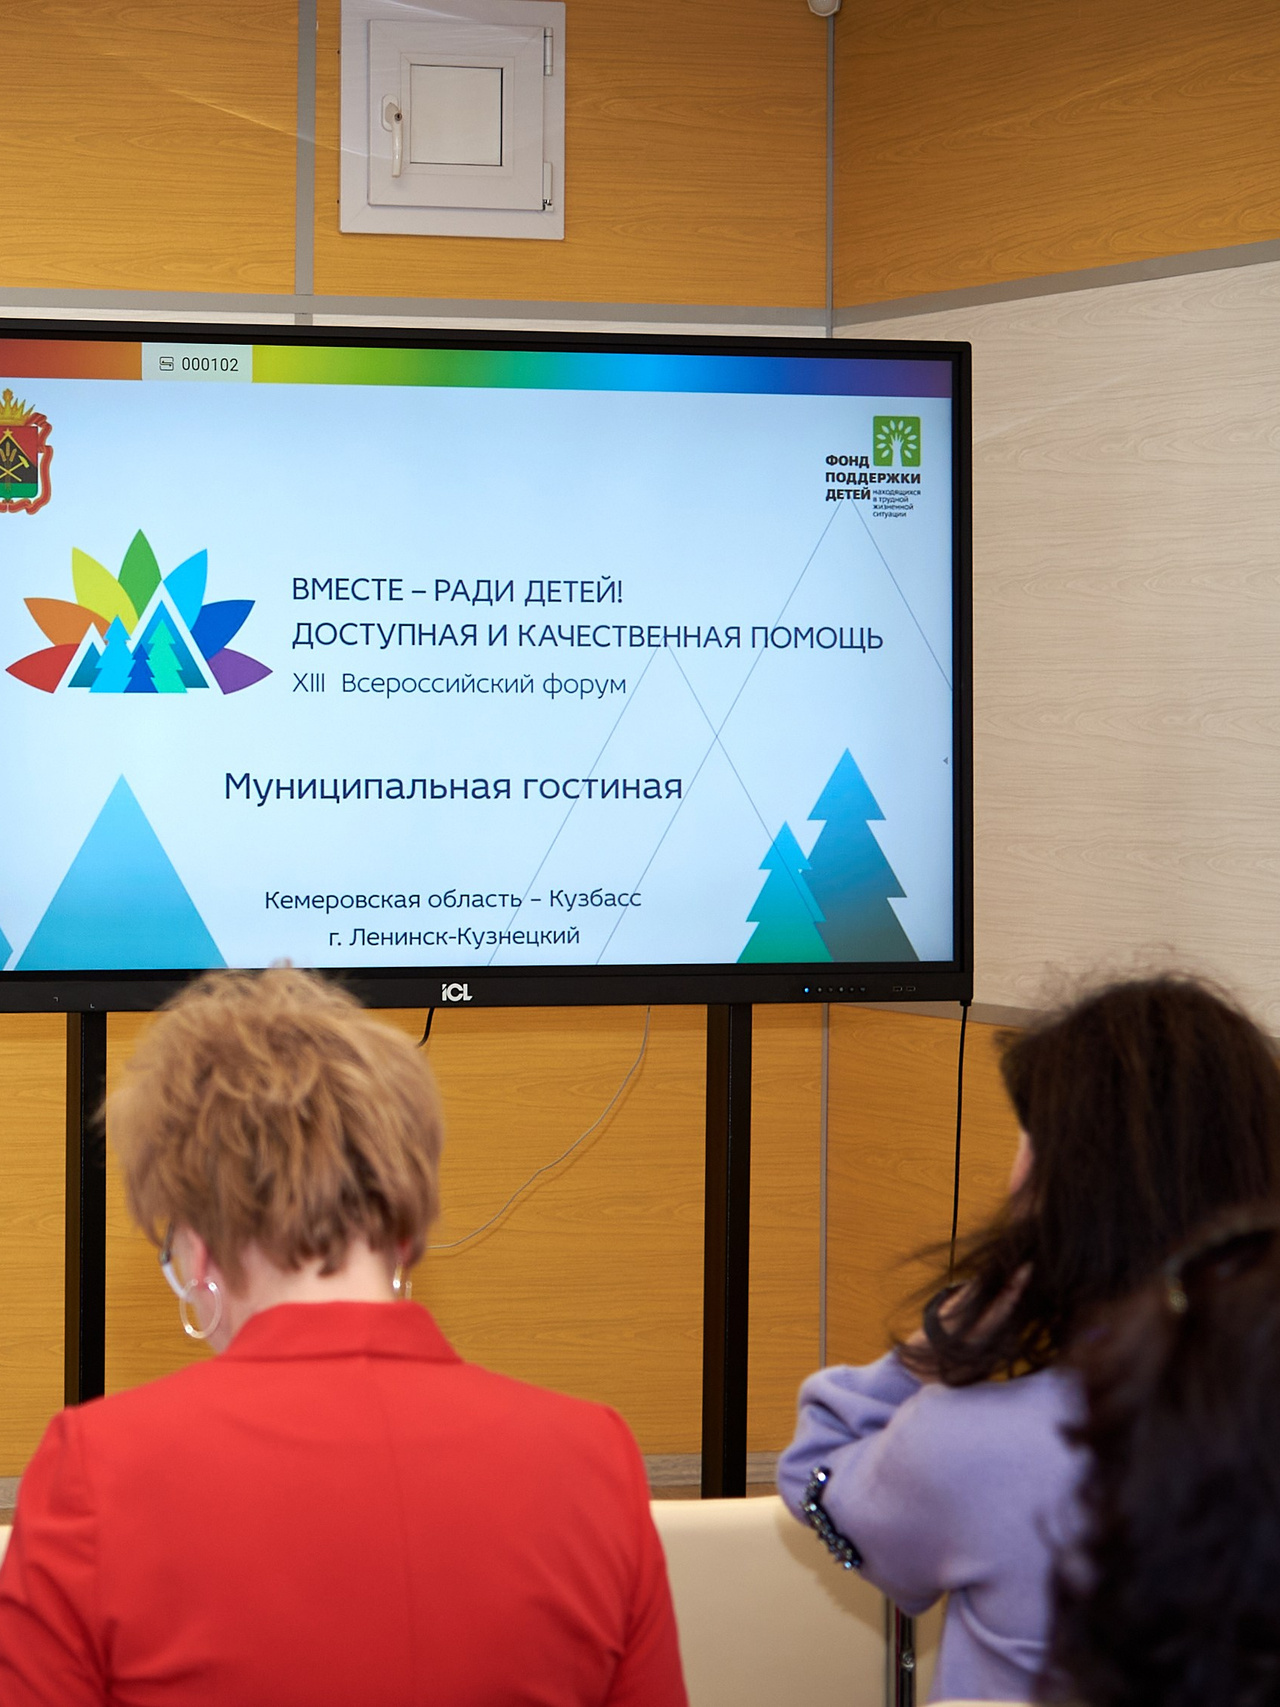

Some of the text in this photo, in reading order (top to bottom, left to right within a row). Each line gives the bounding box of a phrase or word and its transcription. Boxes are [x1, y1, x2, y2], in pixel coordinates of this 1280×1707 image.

[181, 356, 239, 372] 000102
[825, 455, 870, 468] ФОНД
[825, 471, 921, 485] ПОДДЕРЖКИ
[825, 487, 871, 501] ДЕТЕЙ
[873, 502, 914, 510] жизненной
[292, 577, 404, 601] ВМЕСТЕ
[434, 579, 515, 607] РАДИ
[524, 575, 623, 607] ДЕТЕЙ!
[292, 622, 884, 653] ДОСТУПНАЯ И КАЧЕСТВЕННАЯ ПОМОЩЬ
[292, 673, 627, 700] XIII Всероссийский форум
[224, 772, 684, 807] Муниципальная гостиная
[265, 890, 421, 914] Кемеровская
[427, 889, 523, 909] область
[549, 888, 642, 911] Кузбасс
[328, 926, 581, 950] г. Ленинск-Кузнецкий
